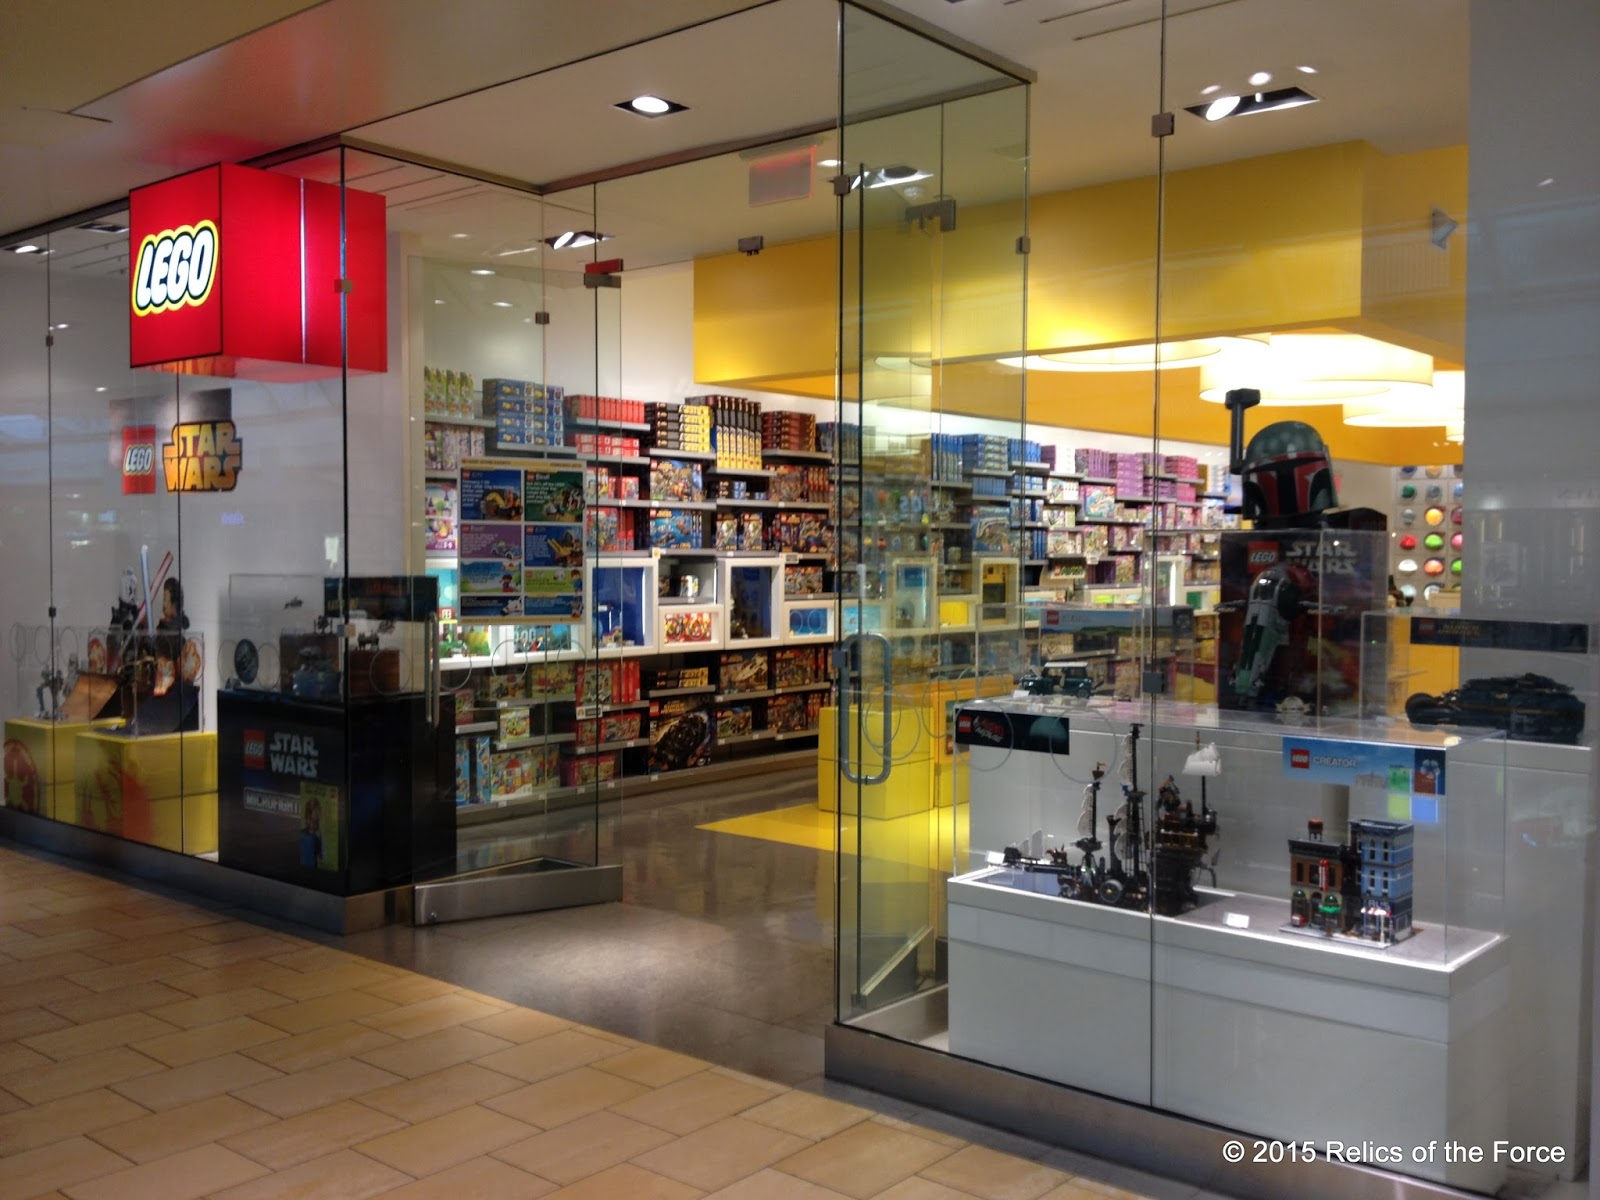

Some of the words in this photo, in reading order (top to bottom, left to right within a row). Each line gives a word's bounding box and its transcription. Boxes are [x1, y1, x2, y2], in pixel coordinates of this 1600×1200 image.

[134, 222, 216, 311] LEGO
[163, 422, 242, 457] STAR
[124, 446, 153, 474] LEGO
[164, 456, 241, 491] WARS
[1249, 551, 1276, 563] LEGO
[1285, 540, 1357, 557] STAR
[269, 731, 319, 757] STAR
[270, 752, 319, 778] WARS
[1313, 756, 1357, 769] CREATOR
